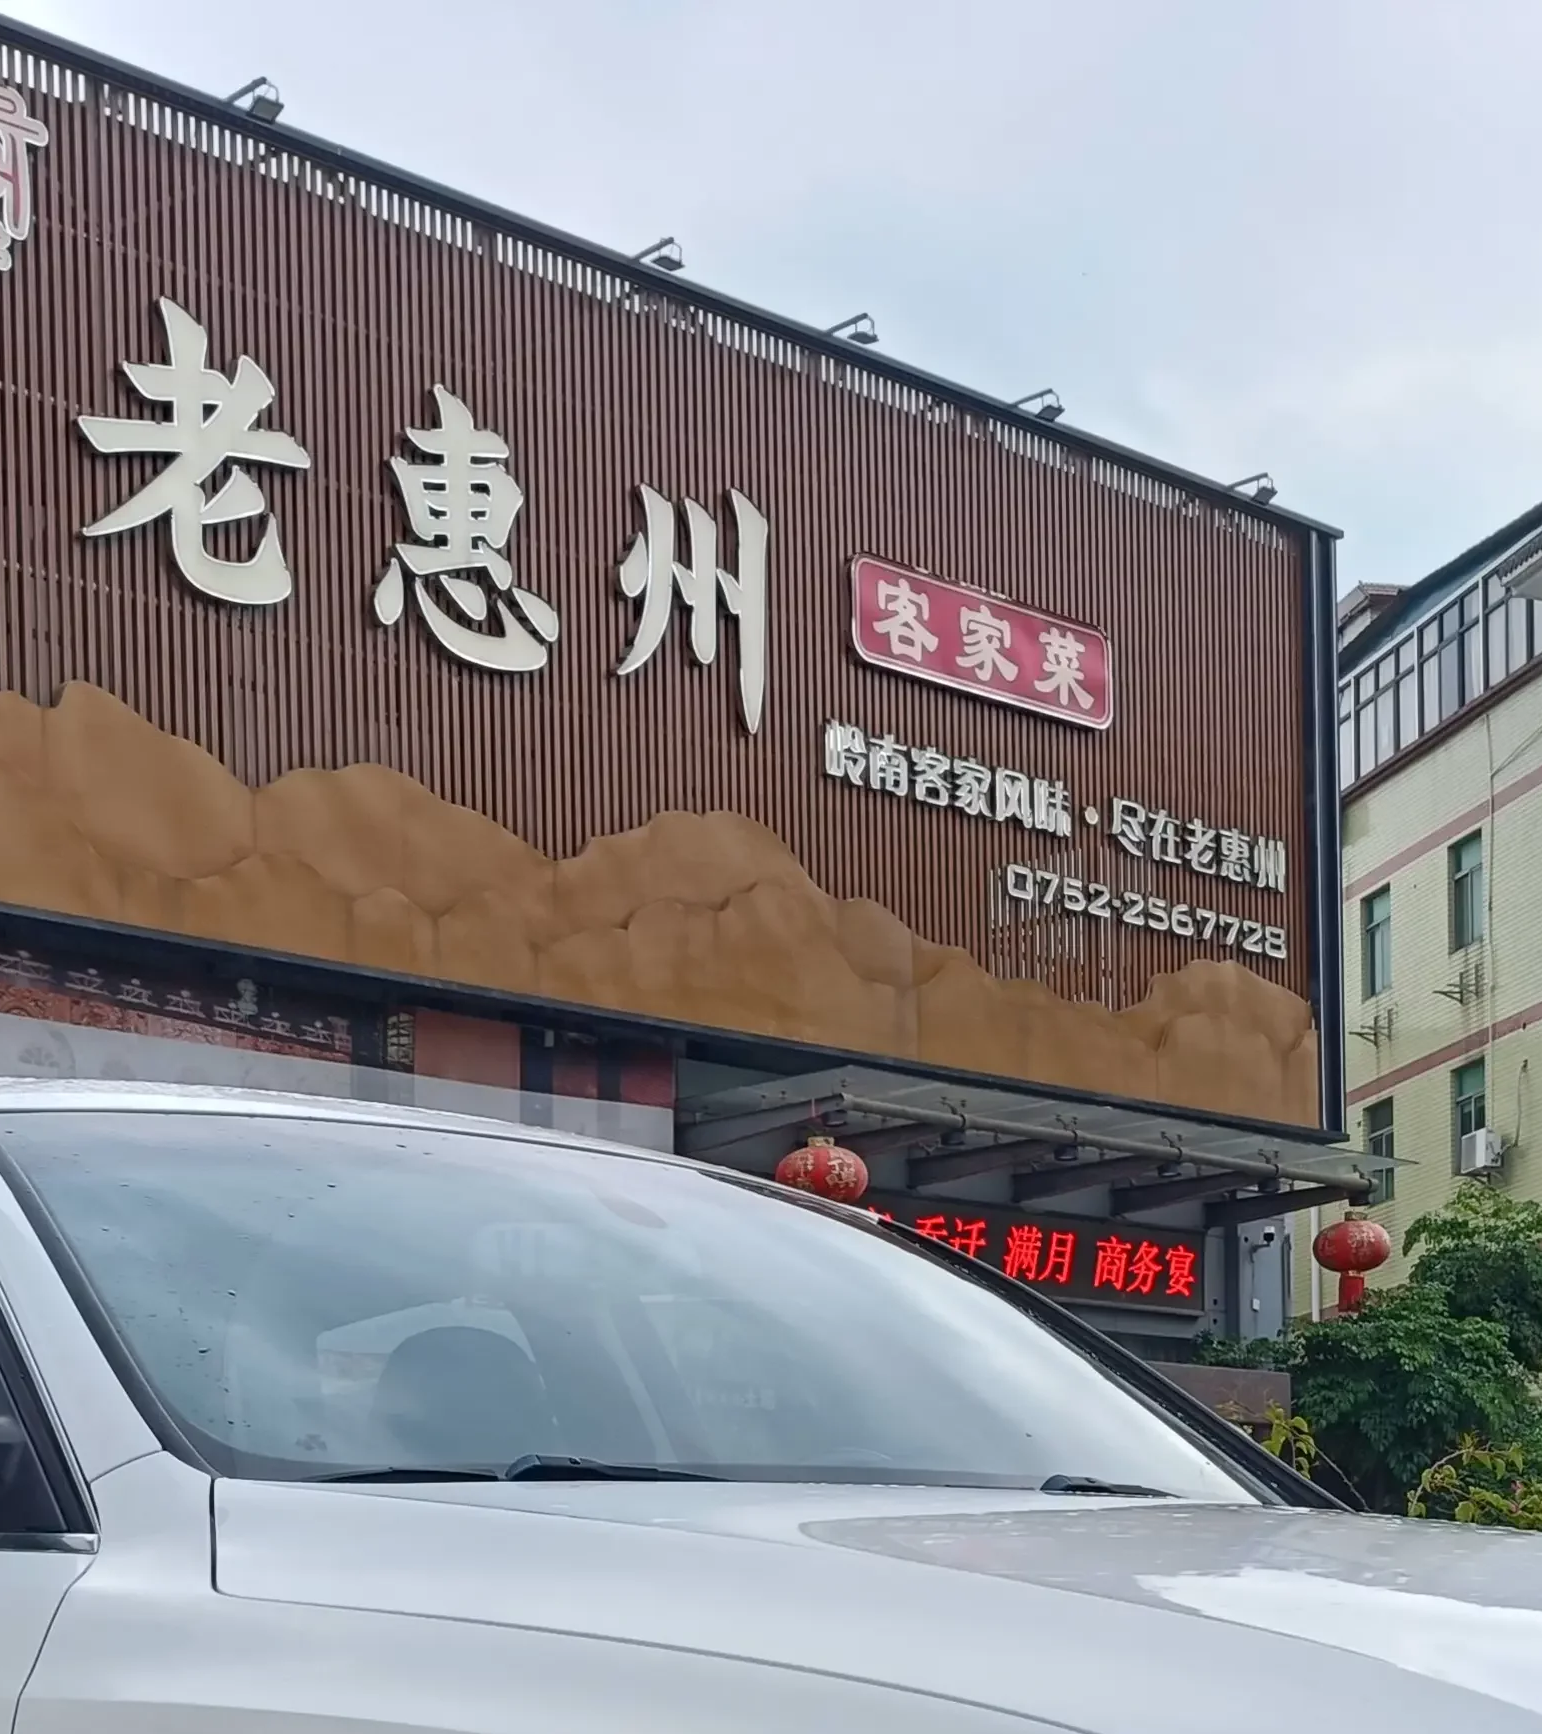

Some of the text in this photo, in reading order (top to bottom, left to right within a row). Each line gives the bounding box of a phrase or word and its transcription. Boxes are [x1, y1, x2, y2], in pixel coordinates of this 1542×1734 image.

[77, 296, 768, 735] 老惠州
[872, 578, 1095, 711] 客家菜
[1007, 864, 1288, 959] 0752-2567728
[1004, 1224, 1076, 1281] 满月
[1094, 1236, 1197, 1297] 商务宴
